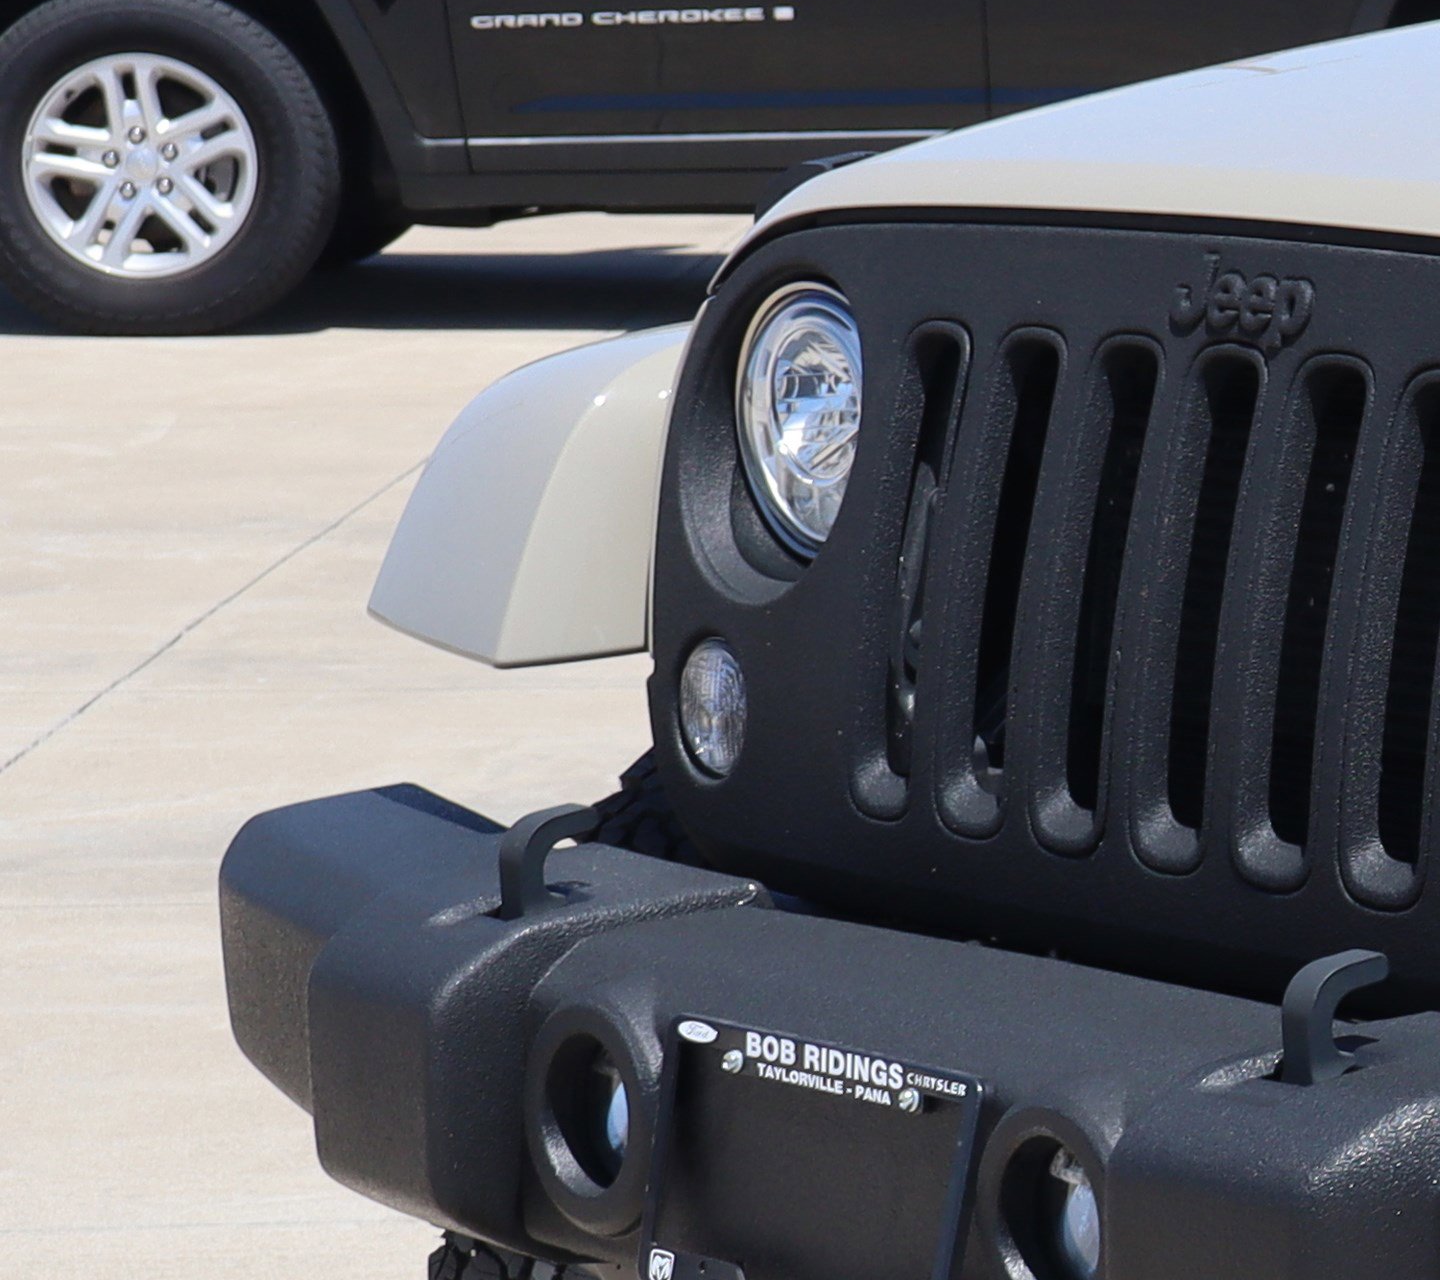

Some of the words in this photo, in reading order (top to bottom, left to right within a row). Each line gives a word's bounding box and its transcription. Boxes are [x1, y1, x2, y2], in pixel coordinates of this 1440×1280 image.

[470, 12, 583, 29] GRAND
[591, 7, 764, 25] CHEROKEE
[1169, 252, 1316, 350] Jeep
[746, 1031, 796, 1065] BOB
[804, 1044, 904, 1090] RIDINGS
[757, 1062, 844, 1094] TAYLORVILLE
[855, 1085, 891, 1106] PANA
[906, 1072, 967, 1097] CHRYSLER
